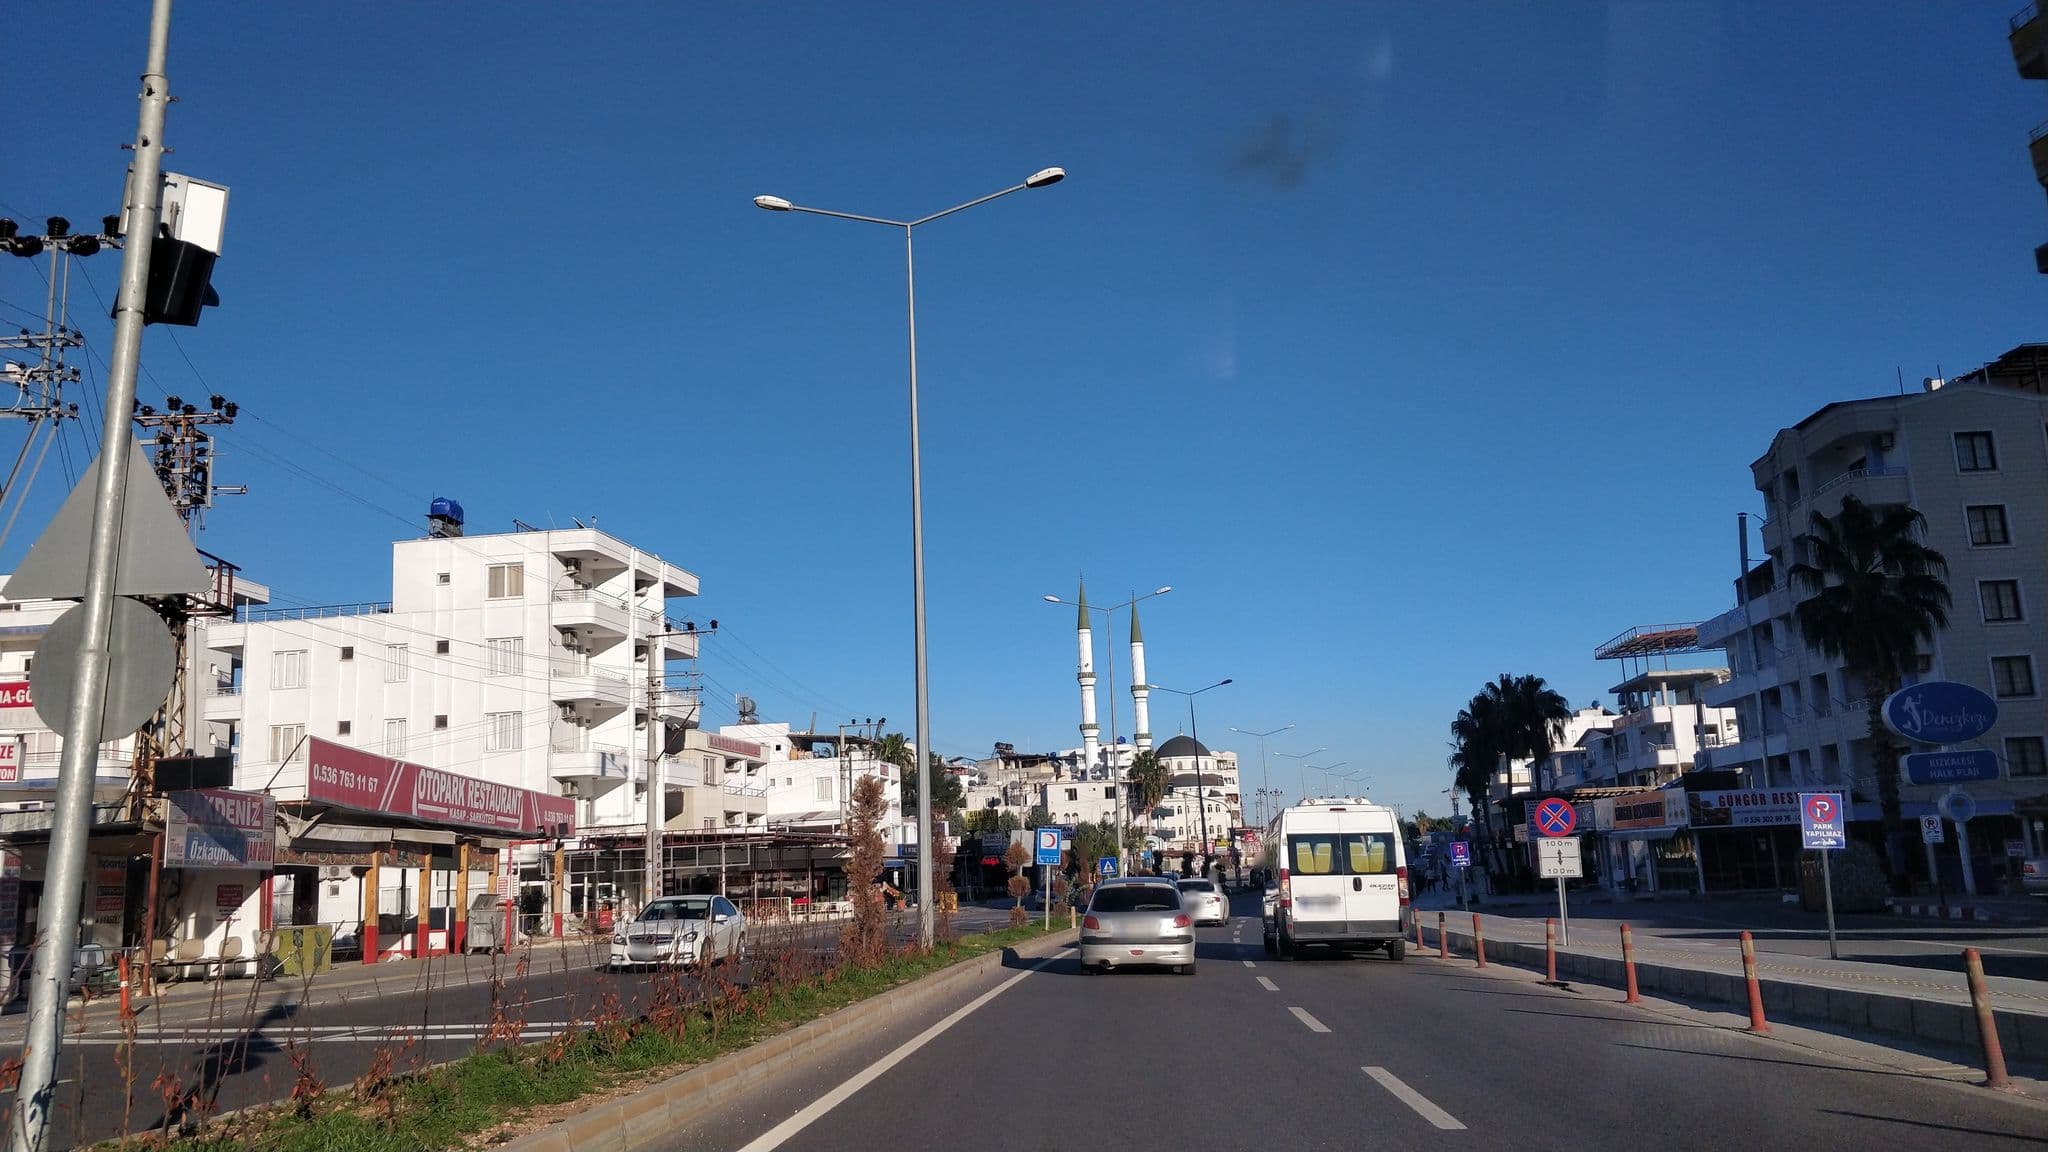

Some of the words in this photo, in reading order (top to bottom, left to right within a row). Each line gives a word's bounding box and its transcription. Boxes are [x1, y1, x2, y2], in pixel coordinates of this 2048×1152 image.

[0, 768, 15, 780] ON
[313, 763, 337, 785] 0.536
[339, 769, 355, 789] 763
[357, 774, 366, 792] 11
[368, 777, 378, 793] 67
[418, 768, 466, 806] OTOPARK
[468, 779, 523, 815] RESTAURANT
[1718, 792, 1766, 807] GÜNGÖR
[449, 807, 467, 821] KASAP
